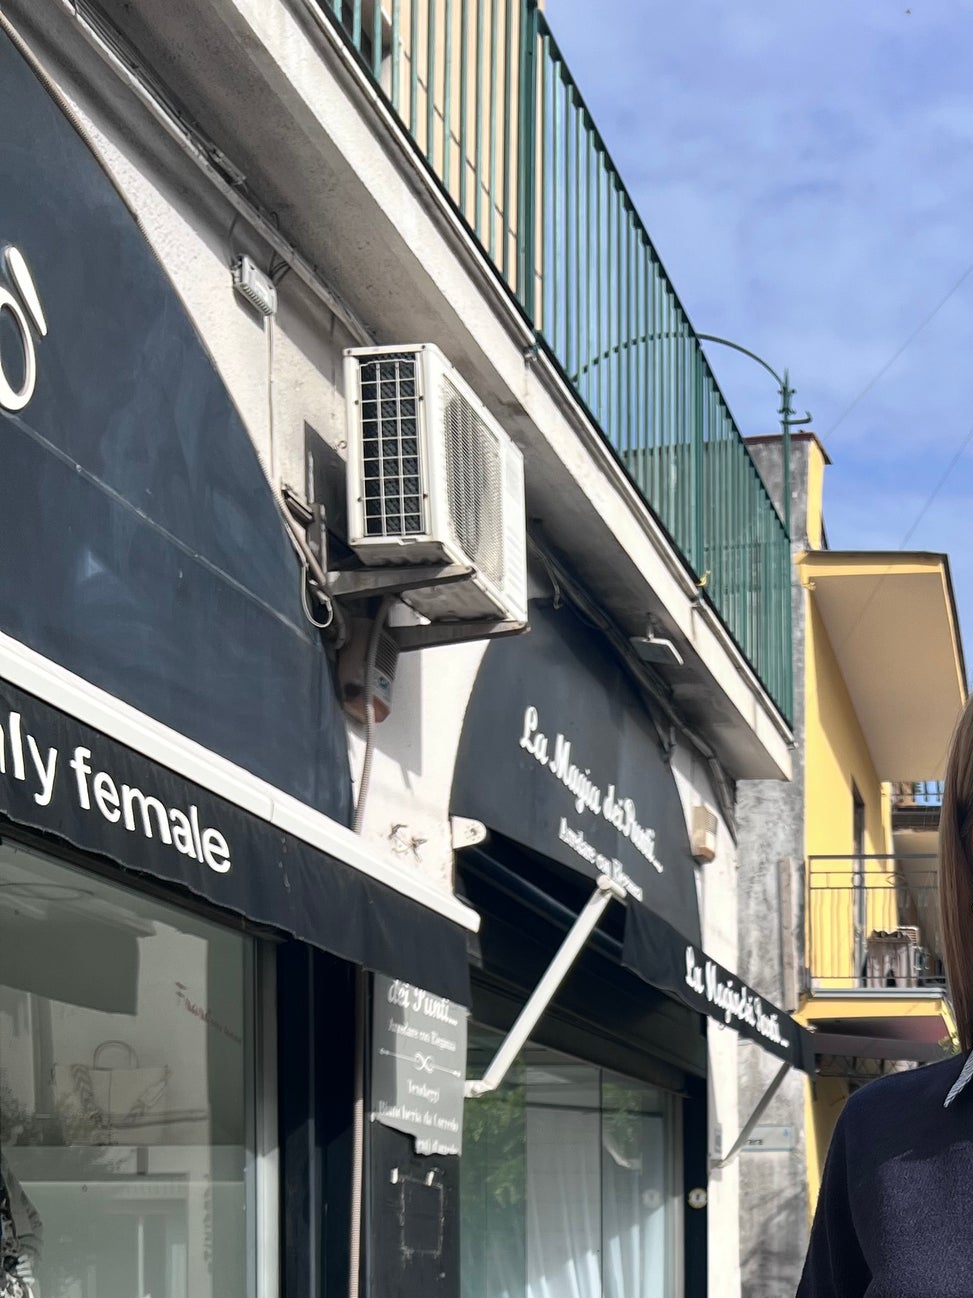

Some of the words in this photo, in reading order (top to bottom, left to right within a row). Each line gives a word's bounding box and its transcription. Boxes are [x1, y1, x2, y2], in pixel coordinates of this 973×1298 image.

[0, 711, 58, 806] ly
[70, 746, 231, 873] female
[519, 706, 549, 765] La
[549, 733, 602, 814] Magia
[685, 946, 705, 994] La
[705, 961, 741, 1024] Magia
